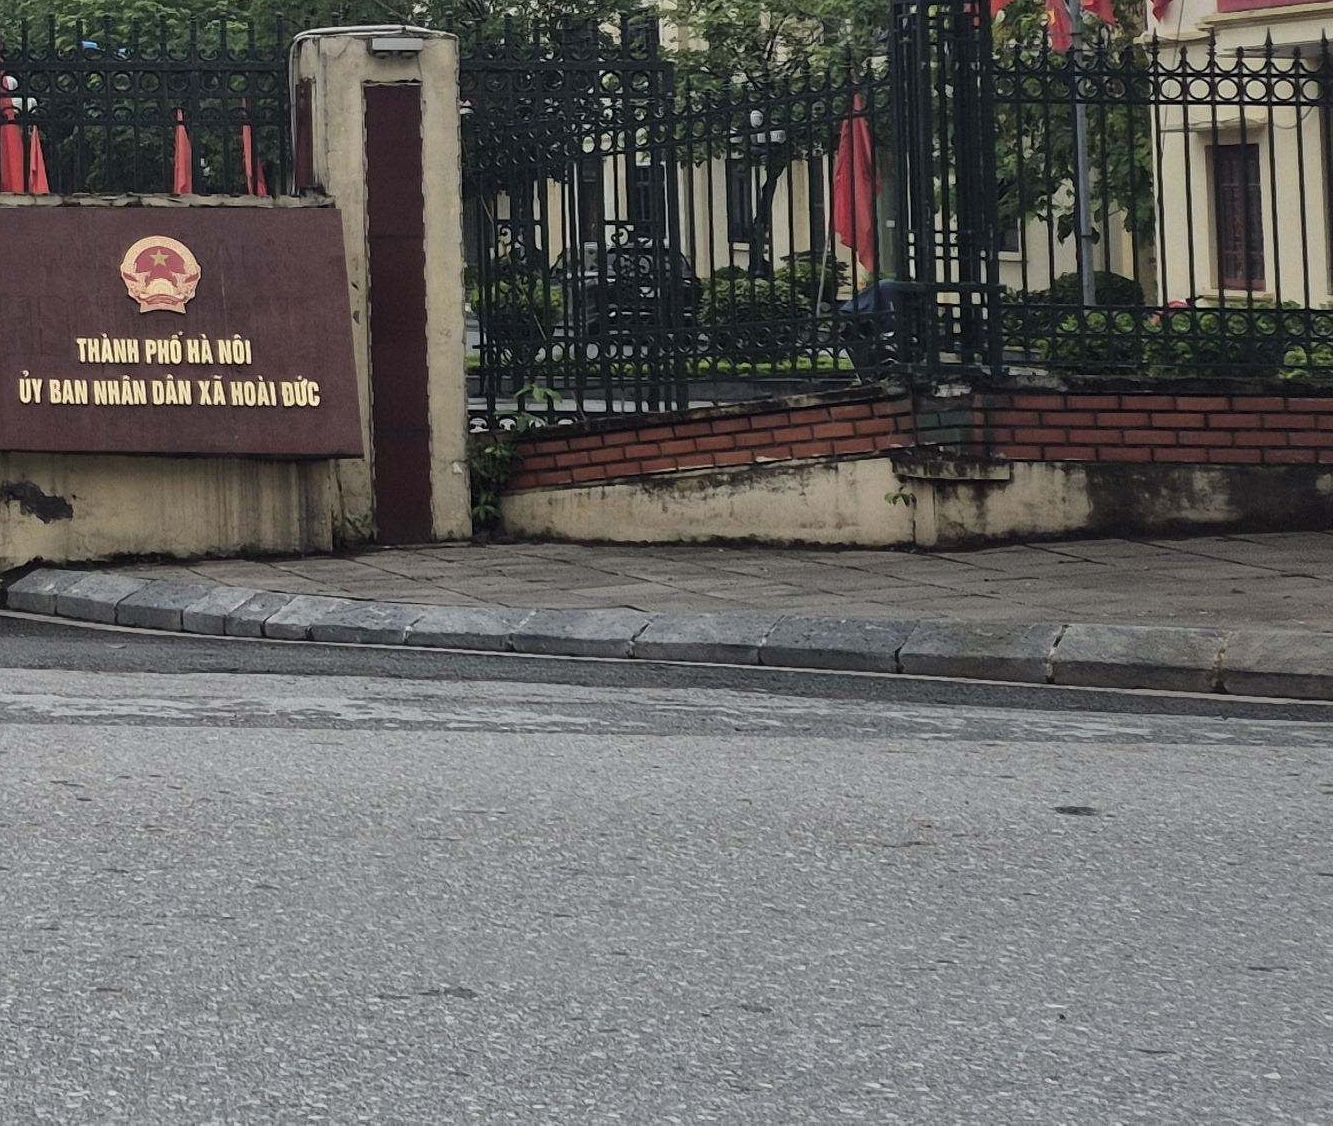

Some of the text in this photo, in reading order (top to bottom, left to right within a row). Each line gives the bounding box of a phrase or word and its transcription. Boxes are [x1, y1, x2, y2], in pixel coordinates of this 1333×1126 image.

[75, 332, 141, 364] THÀNH
[144, 330, 184, 365] PHỐ
[186, 332, 214, 365] HÀ
[18, 370, 321, 407] ỦY BAN NHÂN DÂN XÃ HOÀI ĐỨC
